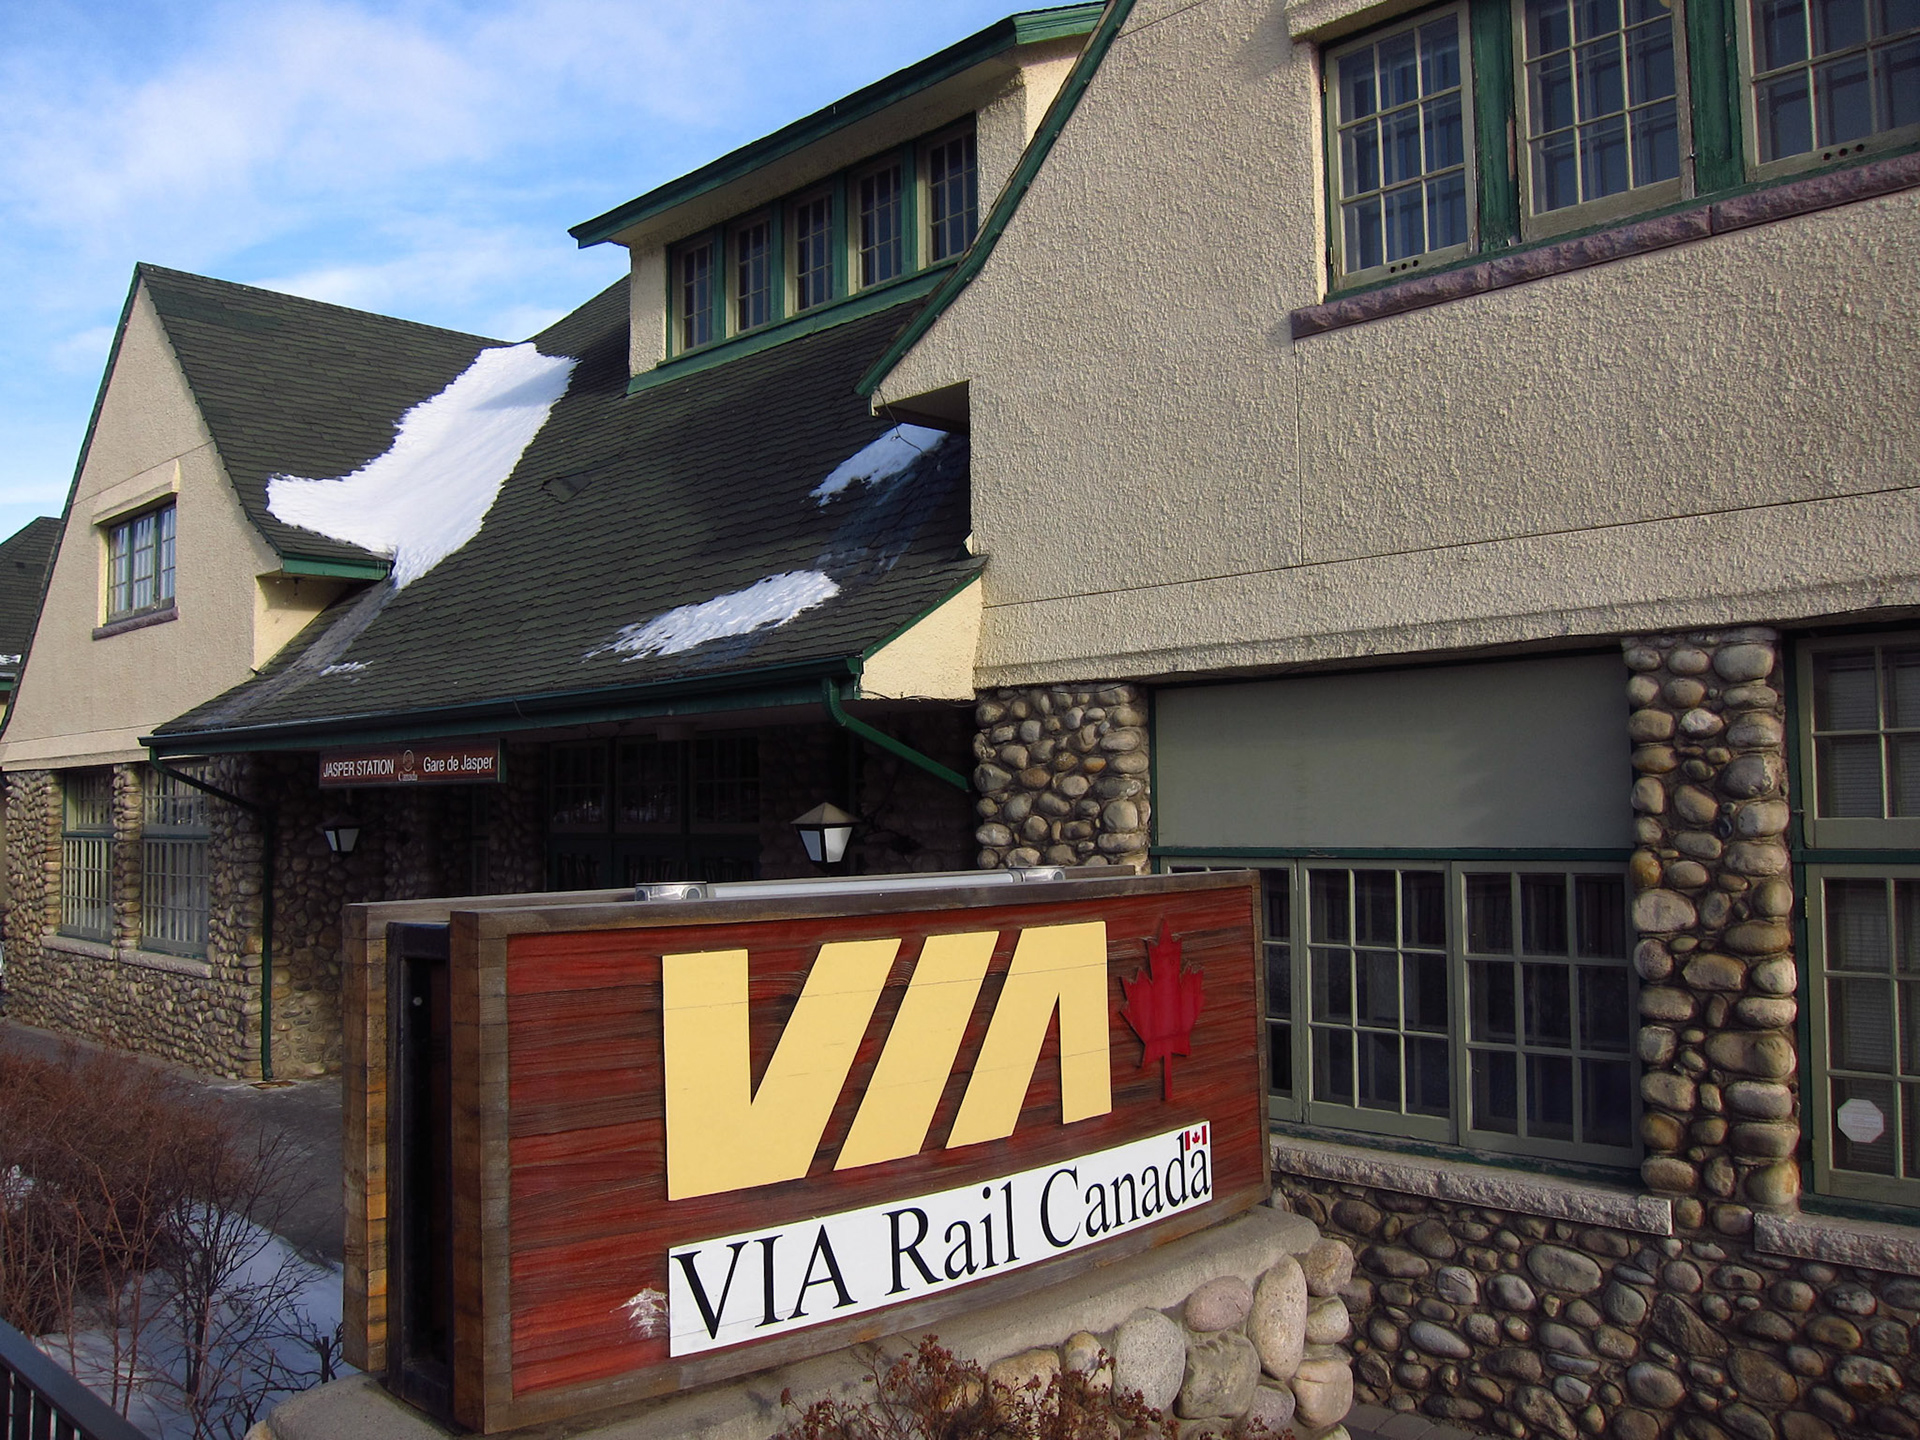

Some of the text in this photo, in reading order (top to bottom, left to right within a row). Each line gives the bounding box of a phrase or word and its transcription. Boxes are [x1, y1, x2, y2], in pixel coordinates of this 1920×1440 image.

[323, 759, 394, 777] JASPER STATION
[423, 755, 493, 773] Gare de Jasper
[662, 921, 1112, 1201] VIA
[671, 1131, 1211, 1340] VIA Rail Canada
